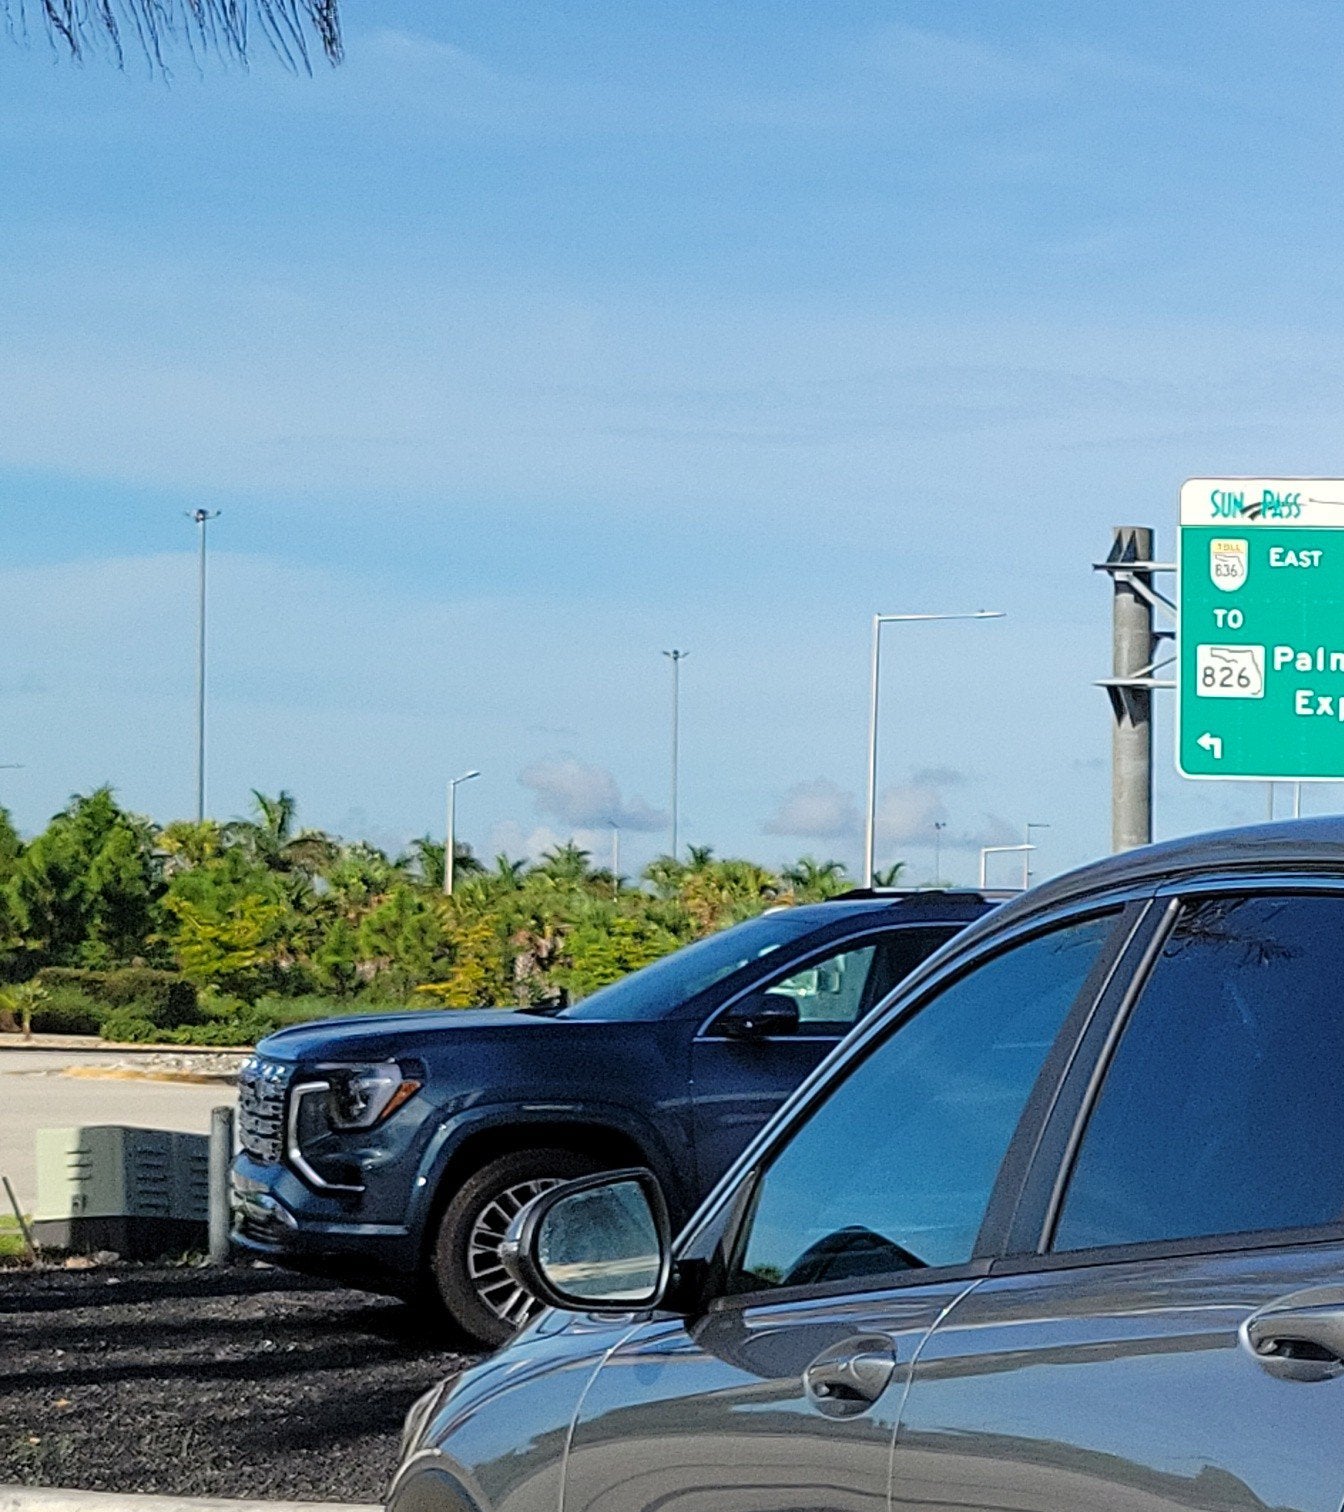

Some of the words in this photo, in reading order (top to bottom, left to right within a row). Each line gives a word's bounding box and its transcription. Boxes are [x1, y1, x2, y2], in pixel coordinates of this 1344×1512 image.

[1217, 543, 1242, 552] TOLL
[1269, 546, 1323, 568] EAST
[1215, 563, 1238, 578] 836
[1212, 608, 1244, 629] TO
[1202, 666, 1251, 688] 826
